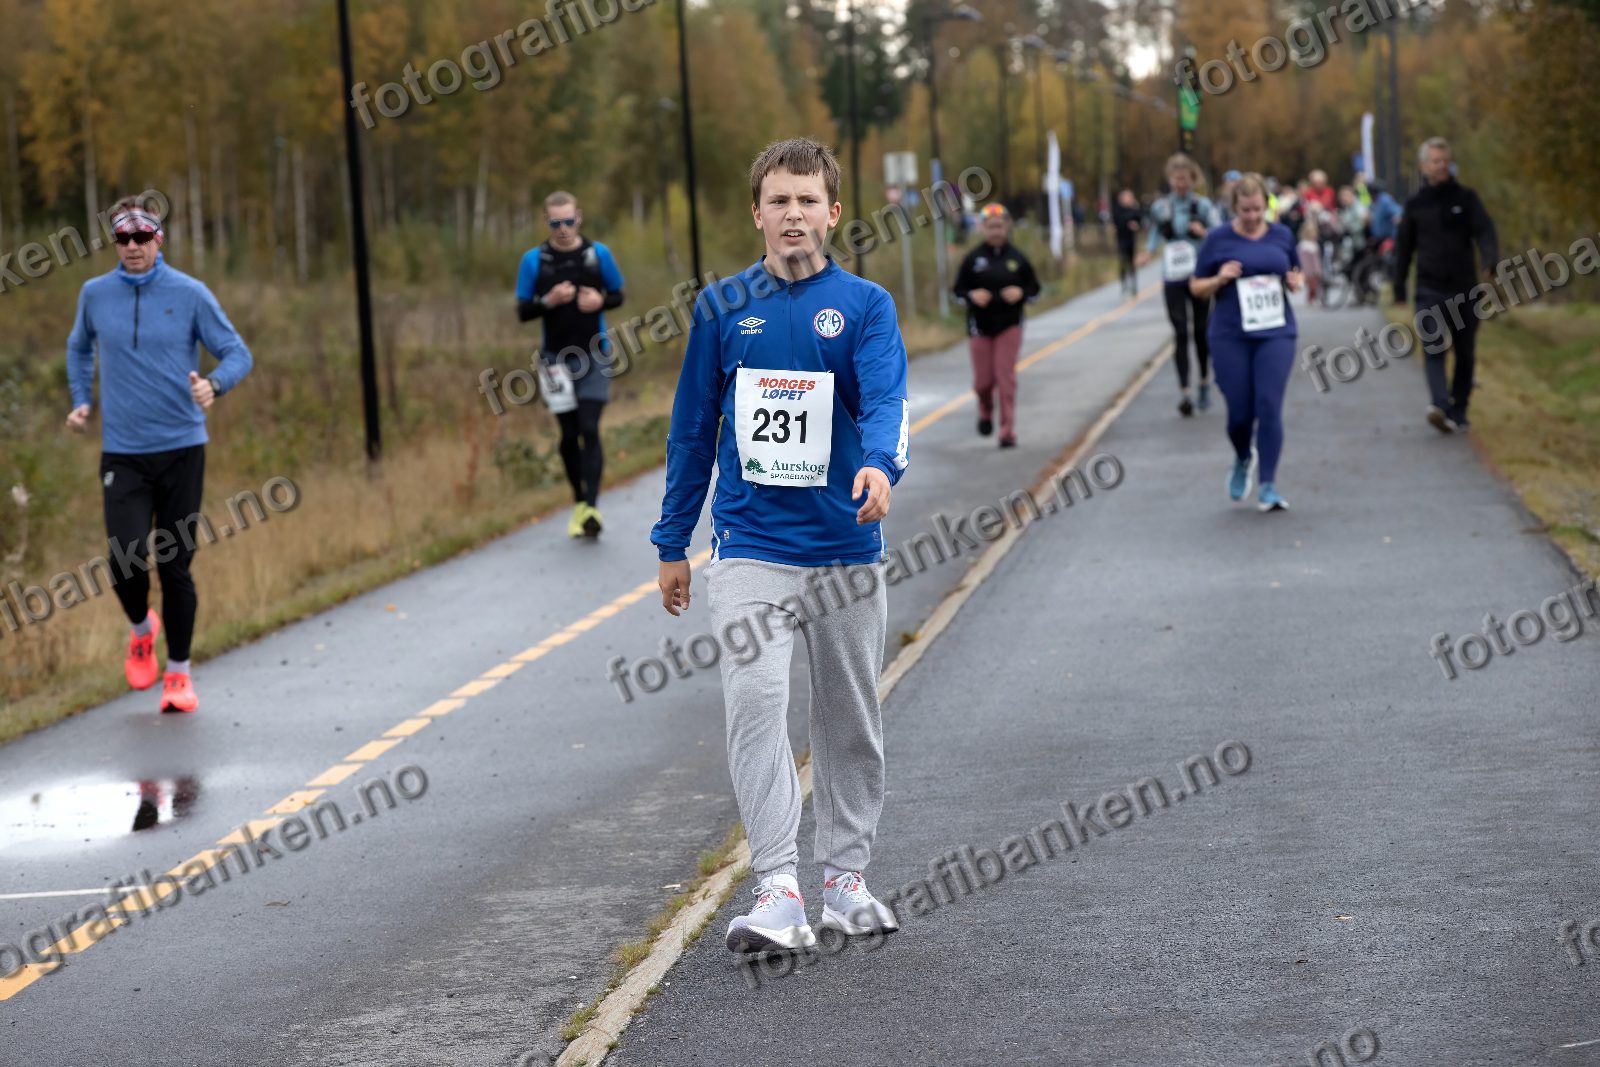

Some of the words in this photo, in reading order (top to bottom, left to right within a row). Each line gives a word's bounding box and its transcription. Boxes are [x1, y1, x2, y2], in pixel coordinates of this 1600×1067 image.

[741, 327, 763, 335] umbro
[754, 377, 816, 391] NORGES
[762, 389, 806, 401] LØPET
[752, 407, 808, 444] 231
[771, 459, 826, 476] Aurskog
[770, 473, 816, 481] SPAREBANK
